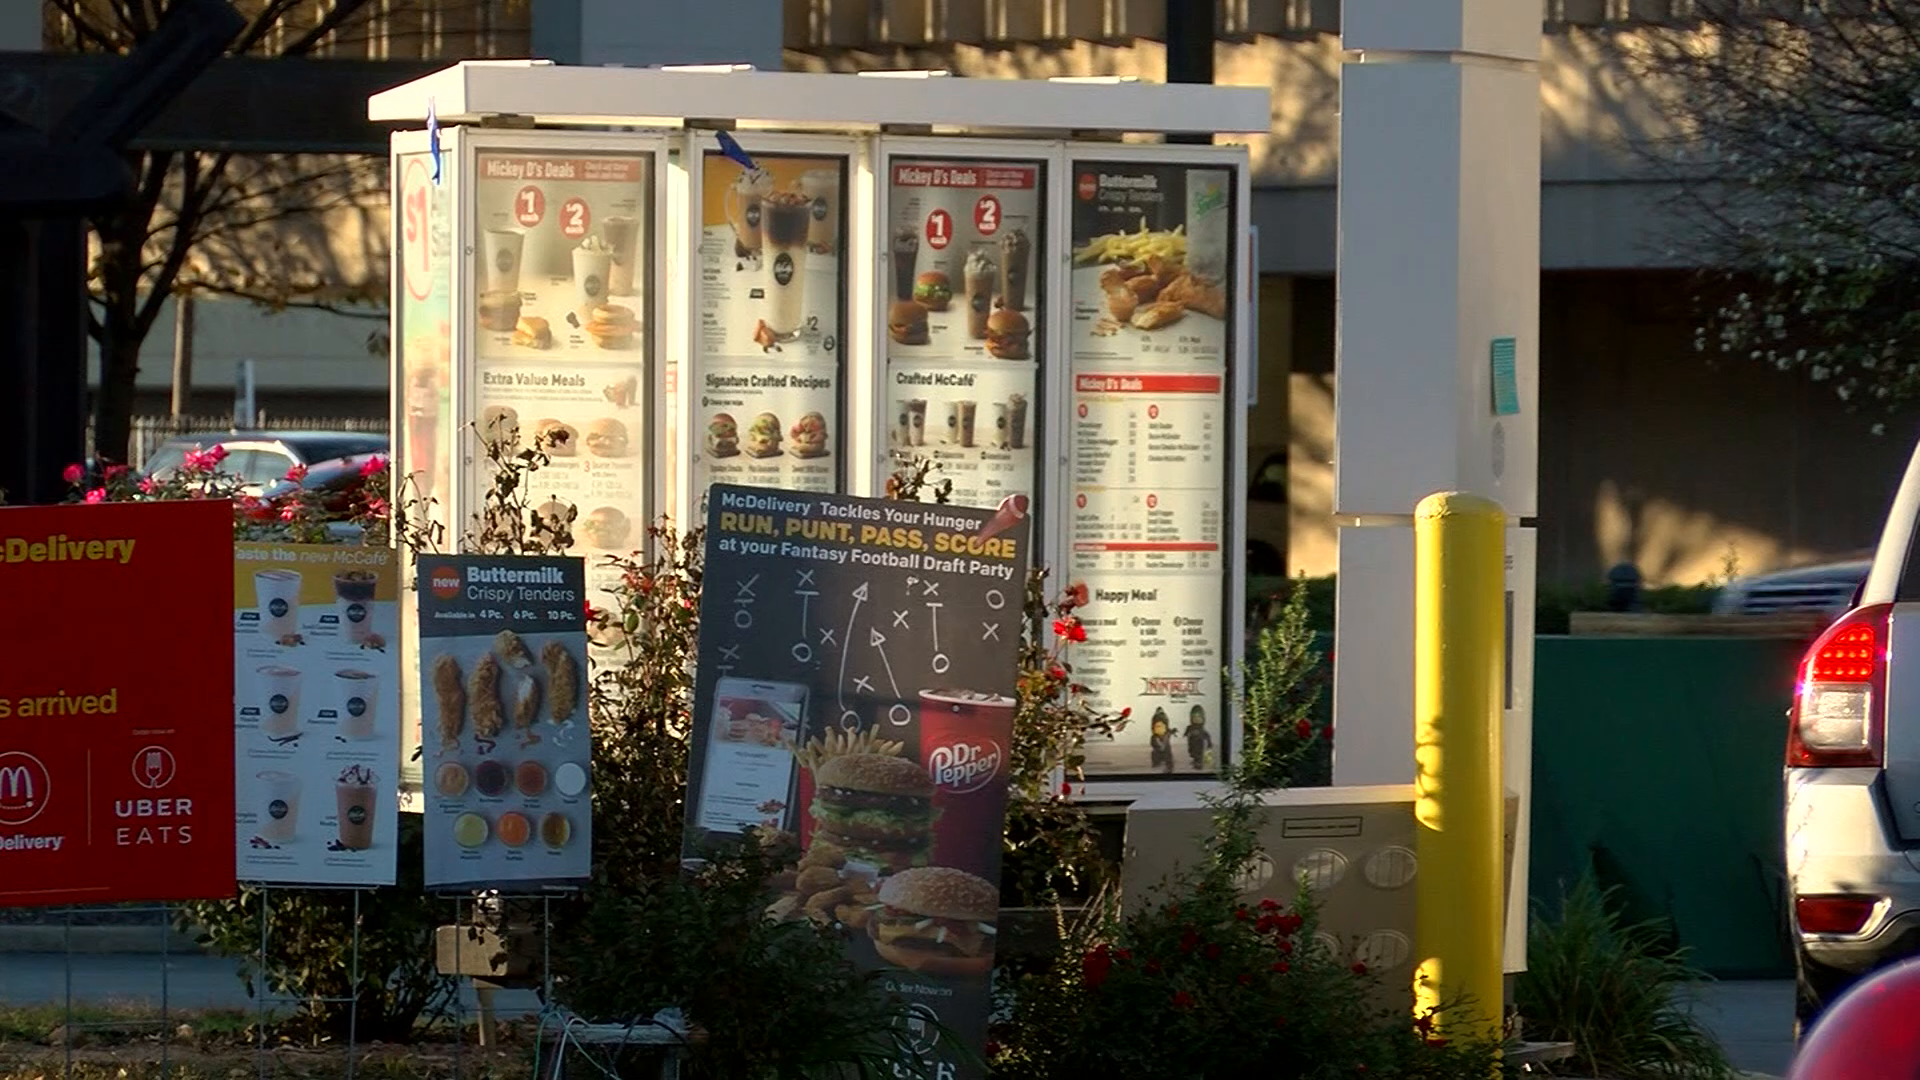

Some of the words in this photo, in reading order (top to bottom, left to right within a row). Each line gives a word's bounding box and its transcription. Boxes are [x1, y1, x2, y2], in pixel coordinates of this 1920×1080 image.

[487, 160, 524, 179] Mickey
[526, 161, 544, 177] D's
[545, 162, 575, 177] Deals
[899, 168, 932, 186] Mickey
[933, 168, 948, 184] D's
[950, 169, 977, 185] Deals
[483, 371, 513, 384] Extra
[515, 373, 548, 385] Value
[552, 374, 585, 387] Meals
[706, 373, 748, 388] Signature
[751, 374, 786, 387] Crafted
[790, 375, 831, 390] Recipes
[897, 372, 932, 385] Crafted
[721, 492, 811, 516] McDelivery
[820, 502, 881, 521] Tackles
[884, 508, 920, 524] Your
[923, 512, 982, 531] Hunger
[720, 511, 779, 538] RUN,
[785, 517, 855, 545] PUNT,
[860, 525, 929, 552] PASS,
[934, 532, 1016, 559] SCORE
[0, 534, 136, 564] Delivery
[234, 546, 268, 560] aste
[272, 548, 296, 562] the
[300, 552, 328, 563] new
[333, 550, 388, 566] McCafé
[719, 537, 737, 551] at
[740, 541, 777, 555] your
[781, 542, 848, 564] Fantasy
[851, 549, 919, 569] Football
[923, 556, 965, 573] Draft
[969, 560, 1014, 581] Party
[432, 577, 460, 588] new
[467, 566, 564, 584] Buttermilk
[467, 585, 514, 603] Crispy
[516, 586, 575, 601] Tenders
[1095, 589, 1129, 603] Happy
[1131, 588, 1157, 600] Meal
[479, 610, 486, 618] 4
[488, 610, 504, 619] Pc.
[513, 610, 519, 618] 6
[521, 610, 537, 619] Pc.
[548, 611, 559, 619] 10
[560, 611, 576, 620] Pc.
[17, 687, 117, 718] arrived
[952, 743, 981, 767] Dr
[932, 746, 997, 788] Pepper
[115, 798, 193, 817] UBER
[117, 826, 192, 845] EATS
